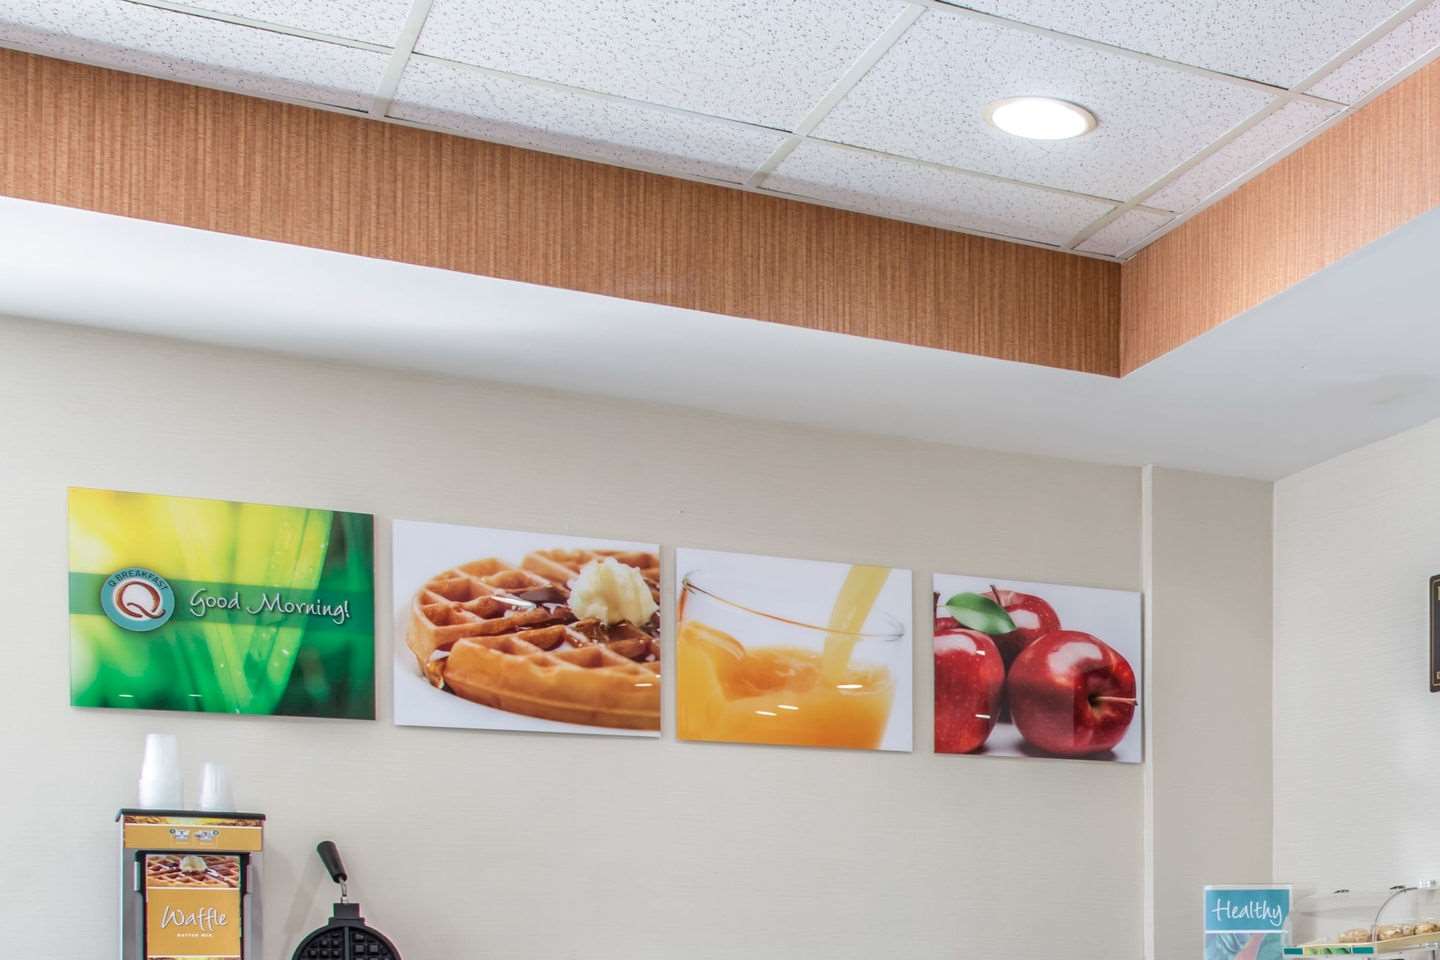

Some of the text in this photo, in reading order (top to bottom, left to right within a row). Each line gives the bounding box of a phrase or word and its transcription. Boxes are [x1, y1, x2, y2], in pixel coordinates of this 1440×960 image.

[189, 588, 351, 625] Good Morning!
[160, 905, 229, 932] Waffle
[1211, 898, 1282, 927] Healthy
